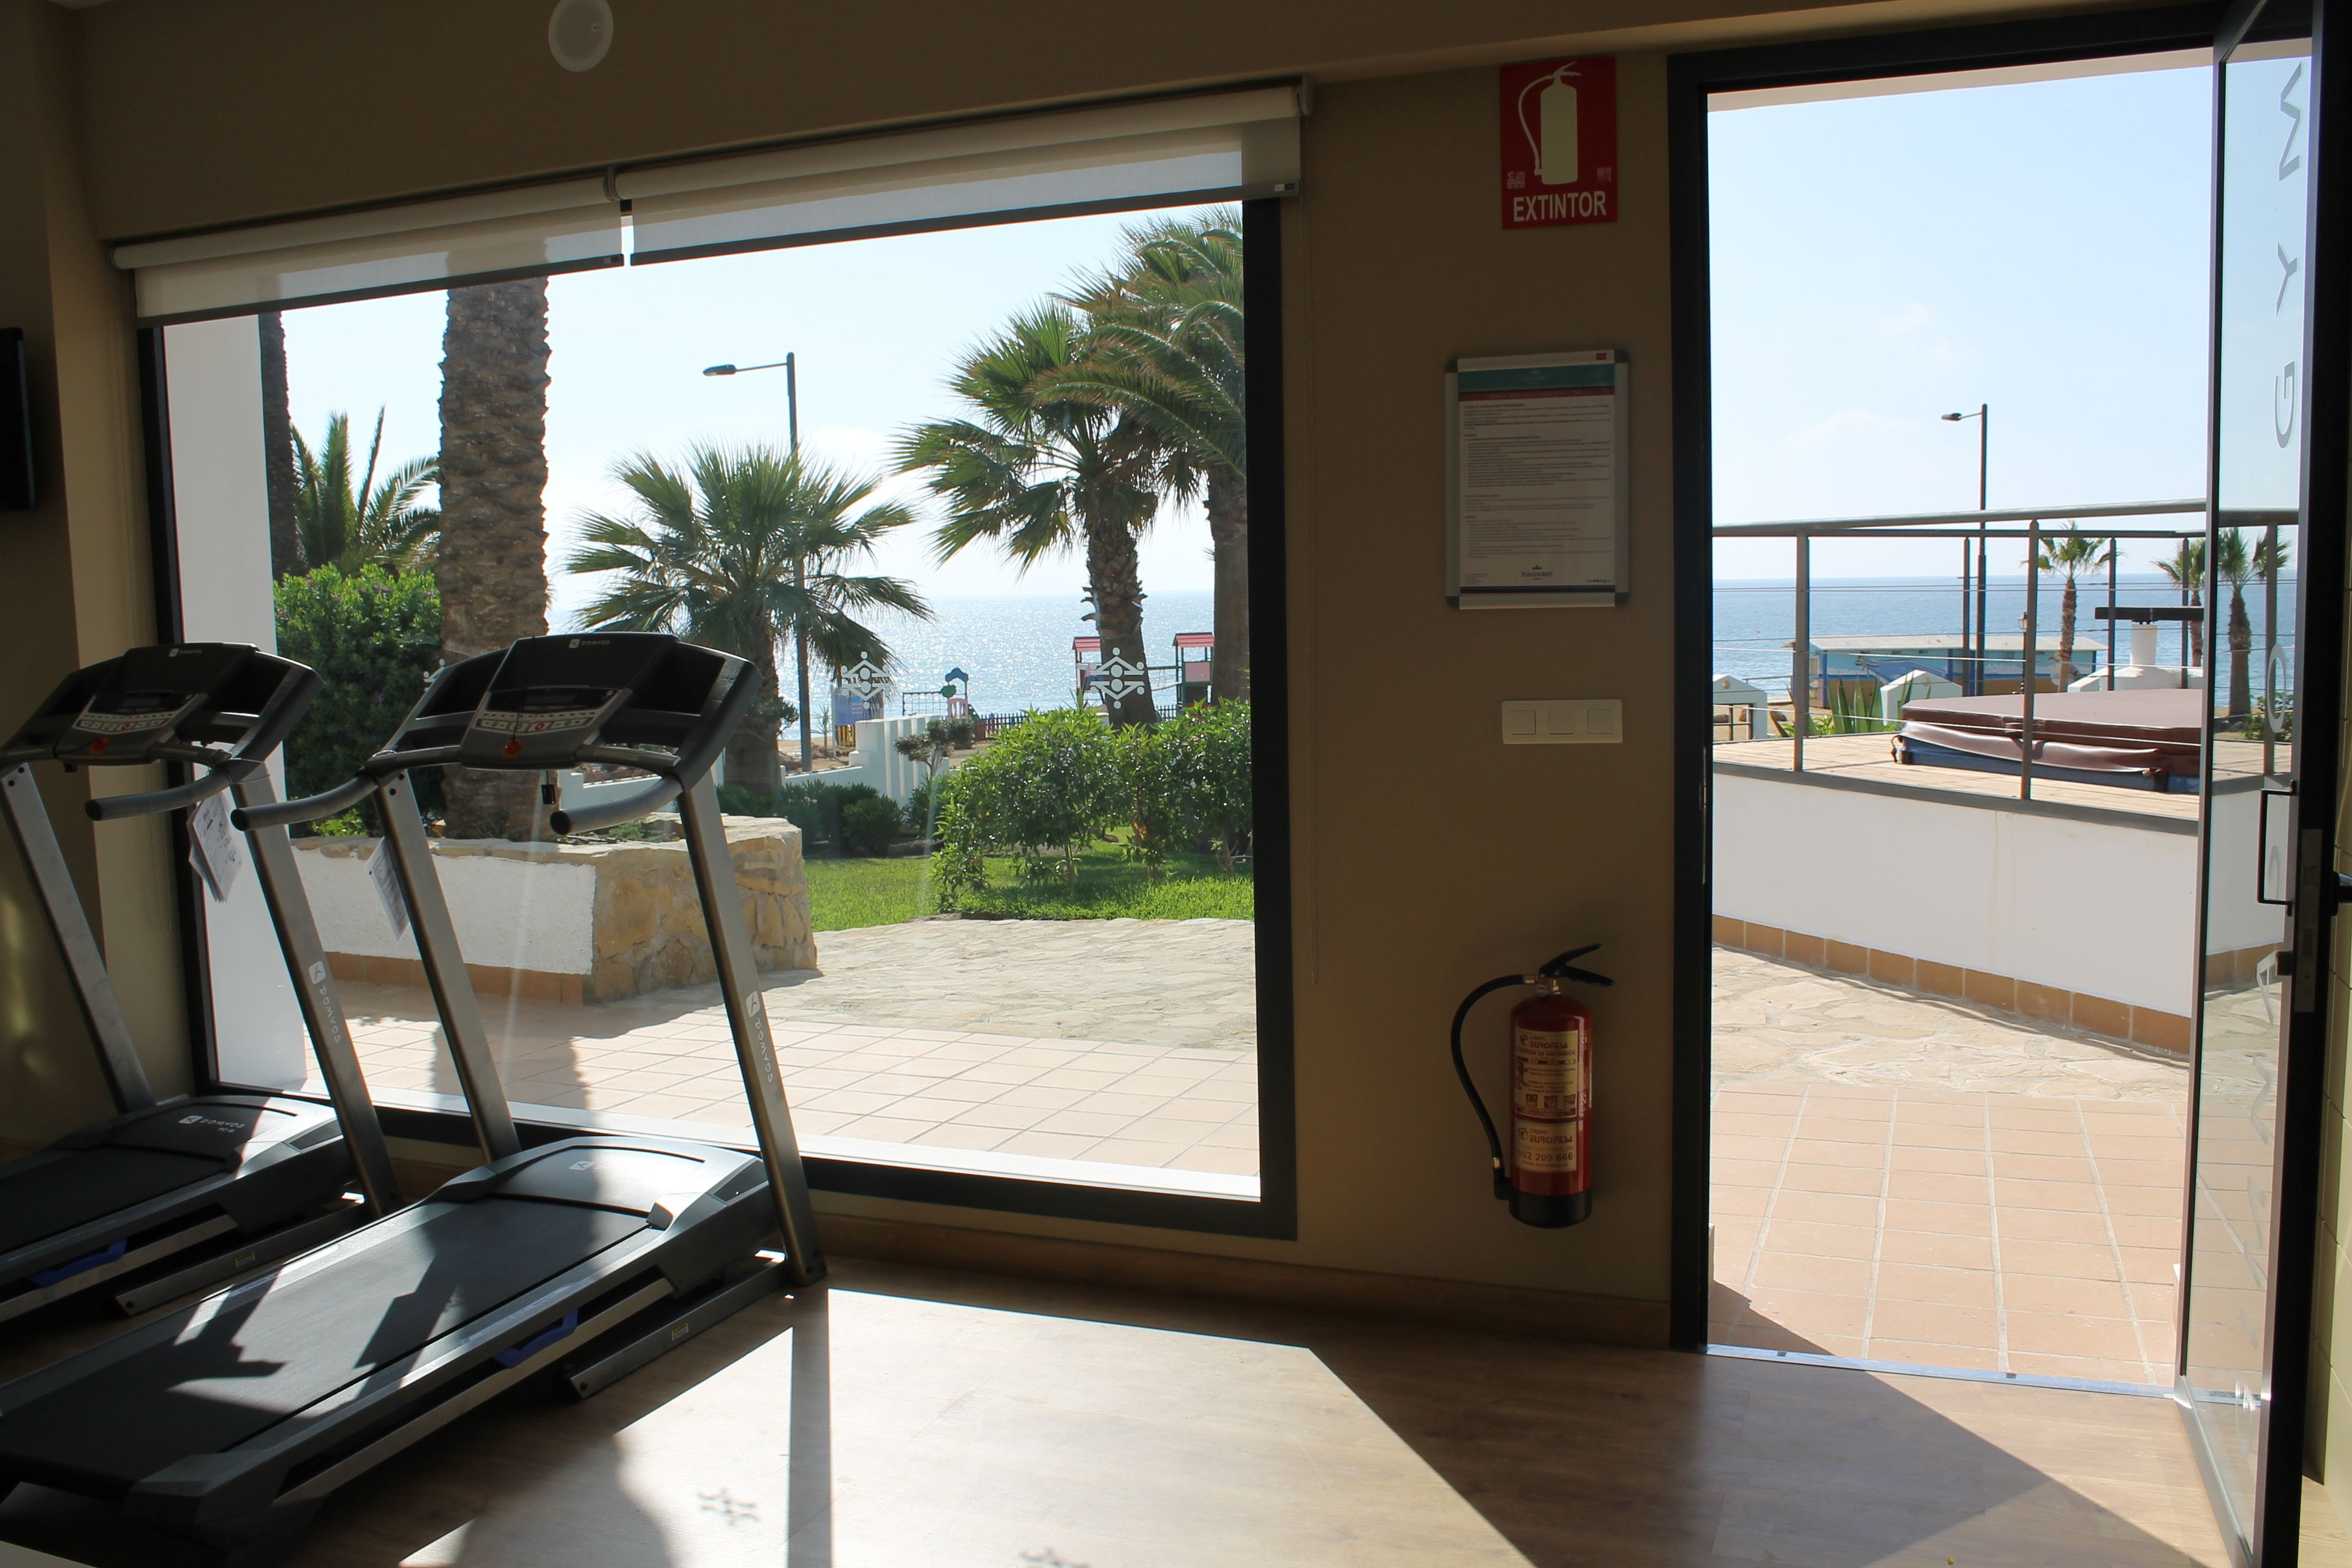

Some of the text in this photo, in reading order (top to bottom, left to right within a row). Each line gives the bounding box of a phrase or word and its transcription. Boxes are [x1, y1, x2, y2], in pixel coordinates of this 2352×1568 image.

[1513, 191, 1607, 222] EXTINTOR
[2274, 61, 2302, 448] GYM
[319, 984, 342, 1043] DOMYOS
[755, 1017, 774, 1082] DOMYOS
[1529, 1134, 1574, 1144] EUROFESA
[1535, 1153, 1553, 1162] 209
[1556, 1152, 1574, 1162] 666
